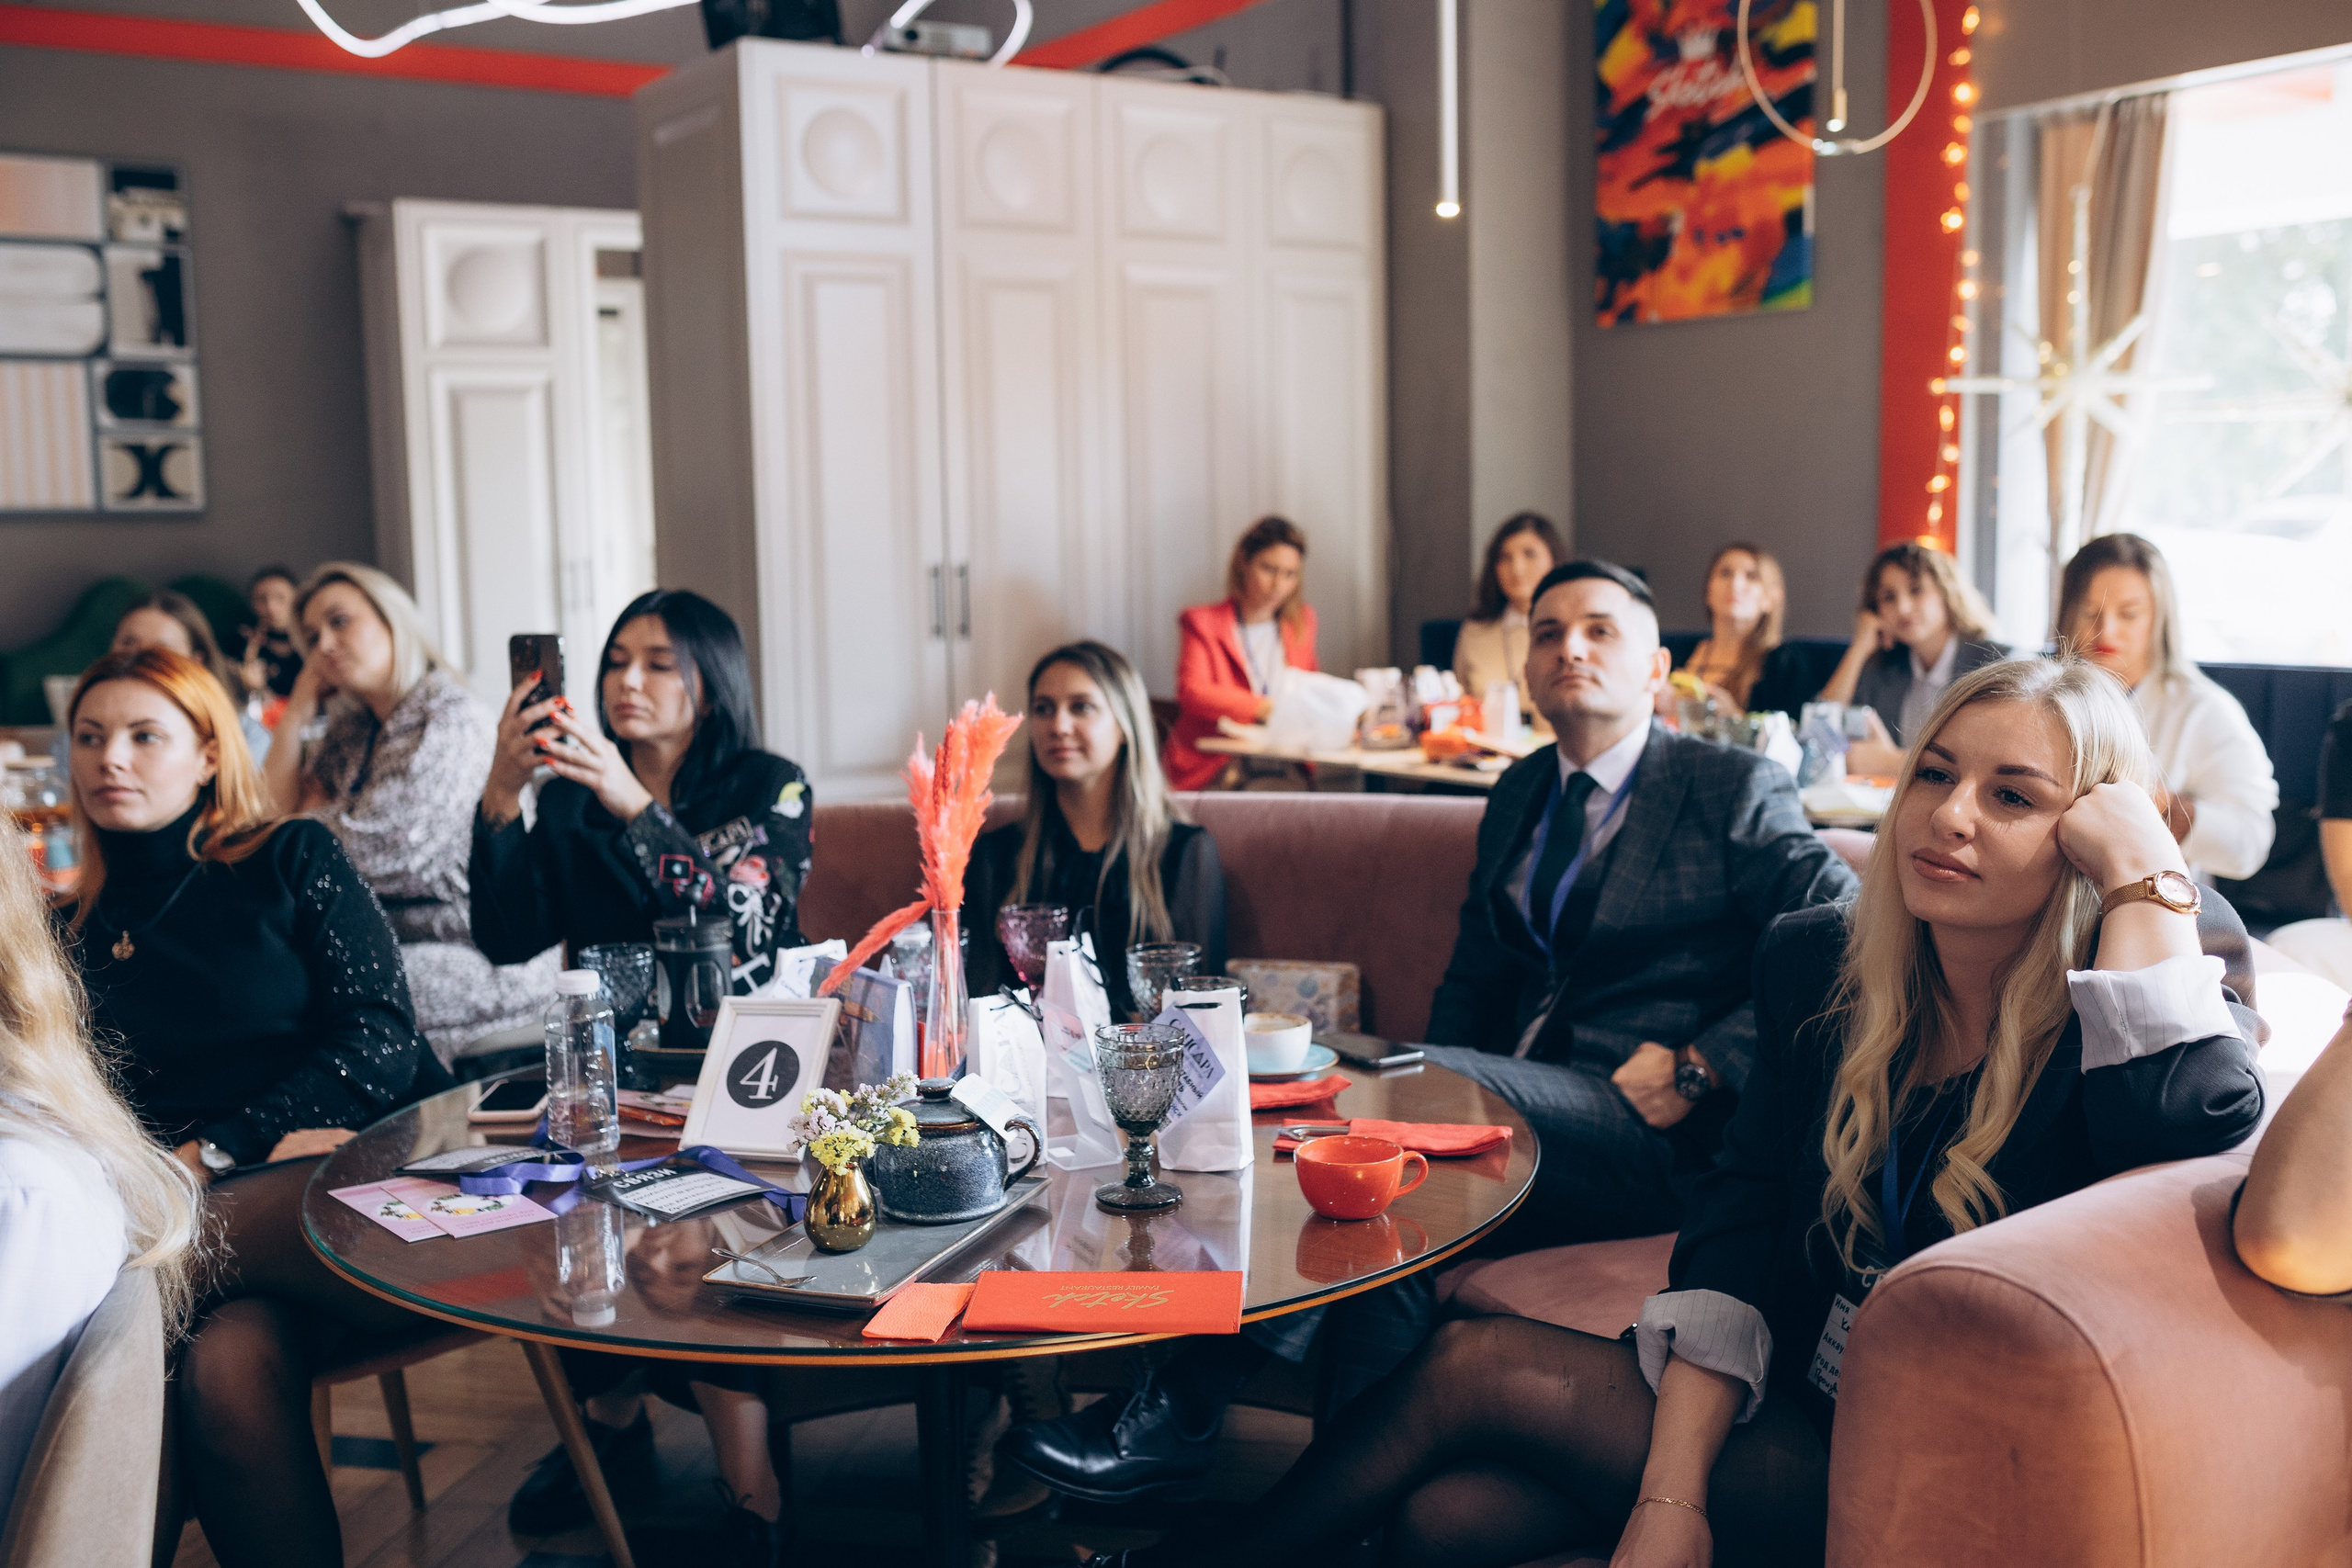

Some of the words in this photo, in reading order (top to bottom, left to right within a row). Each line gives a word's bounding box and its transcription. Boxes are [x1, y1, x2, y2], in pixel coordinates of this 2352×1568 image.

[739, 1046, 779, 1100] 4
[1042, 1289, 1175, 1310] Sketch
[1835, 1297, 1849, 1314] Имя
[1822, 1332, 1844, 1355] Аккау
[1815, 1352, 1829, 1370] Род
